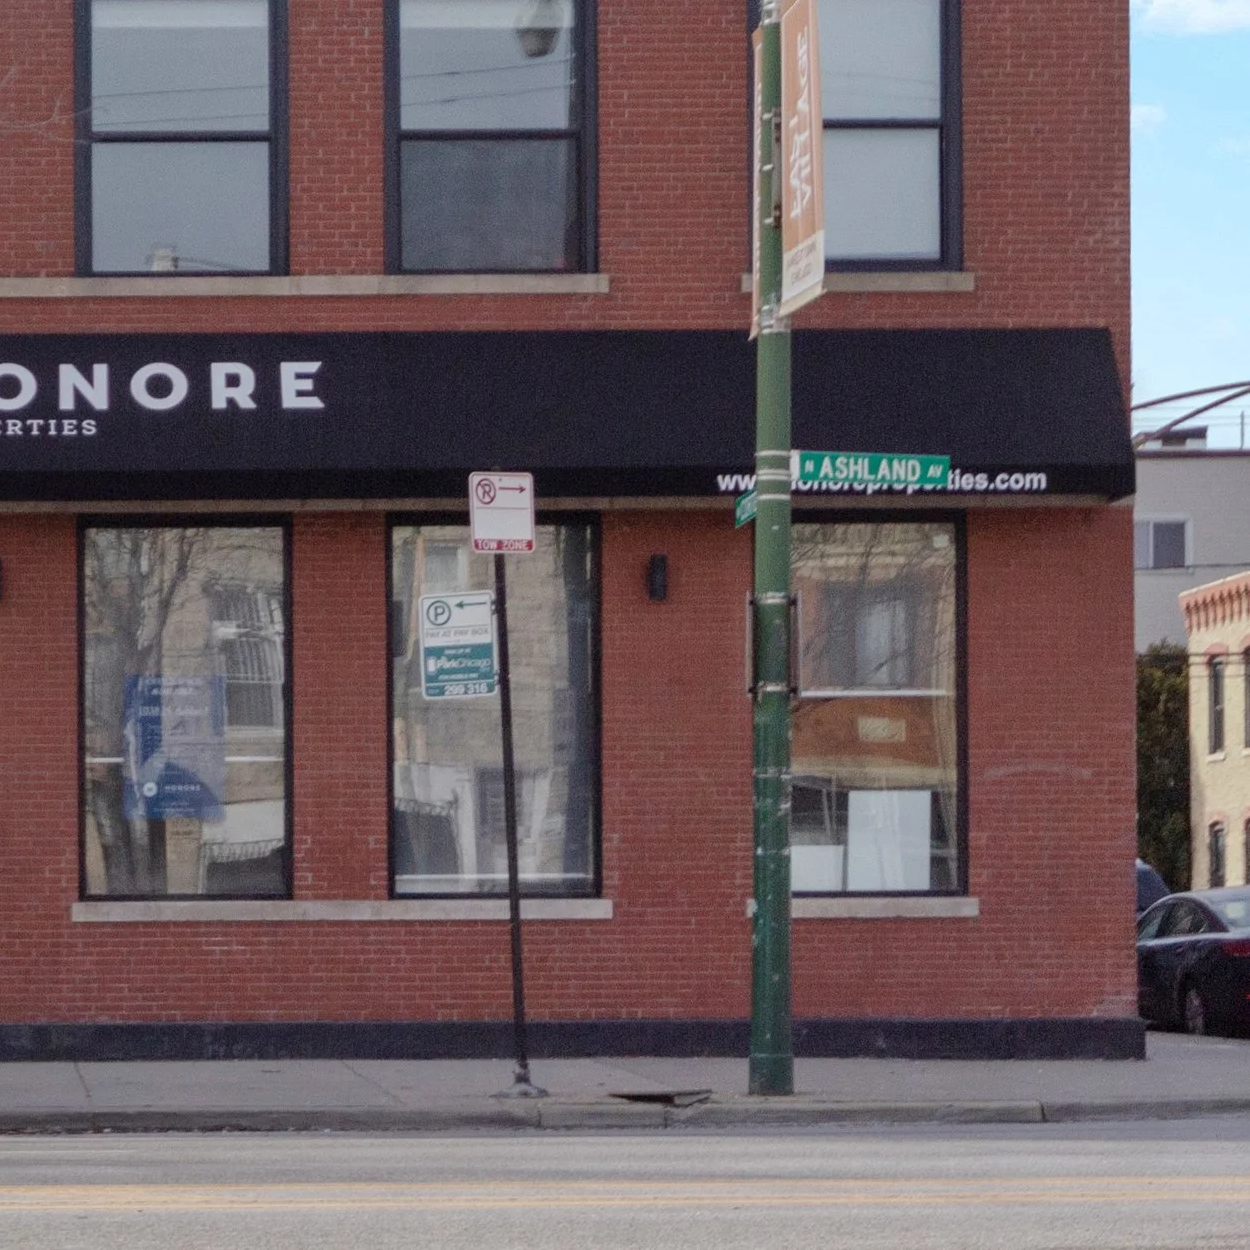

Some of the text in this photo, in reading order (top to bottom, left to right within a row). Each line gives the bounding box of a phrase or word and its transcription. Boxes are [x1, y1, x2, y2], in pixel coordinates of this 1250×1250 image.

[819, 456, 922, 482] ASHLAND
[926, 464, 943, 479] AV
[477, 539, 528, 551] TOW ZONE
